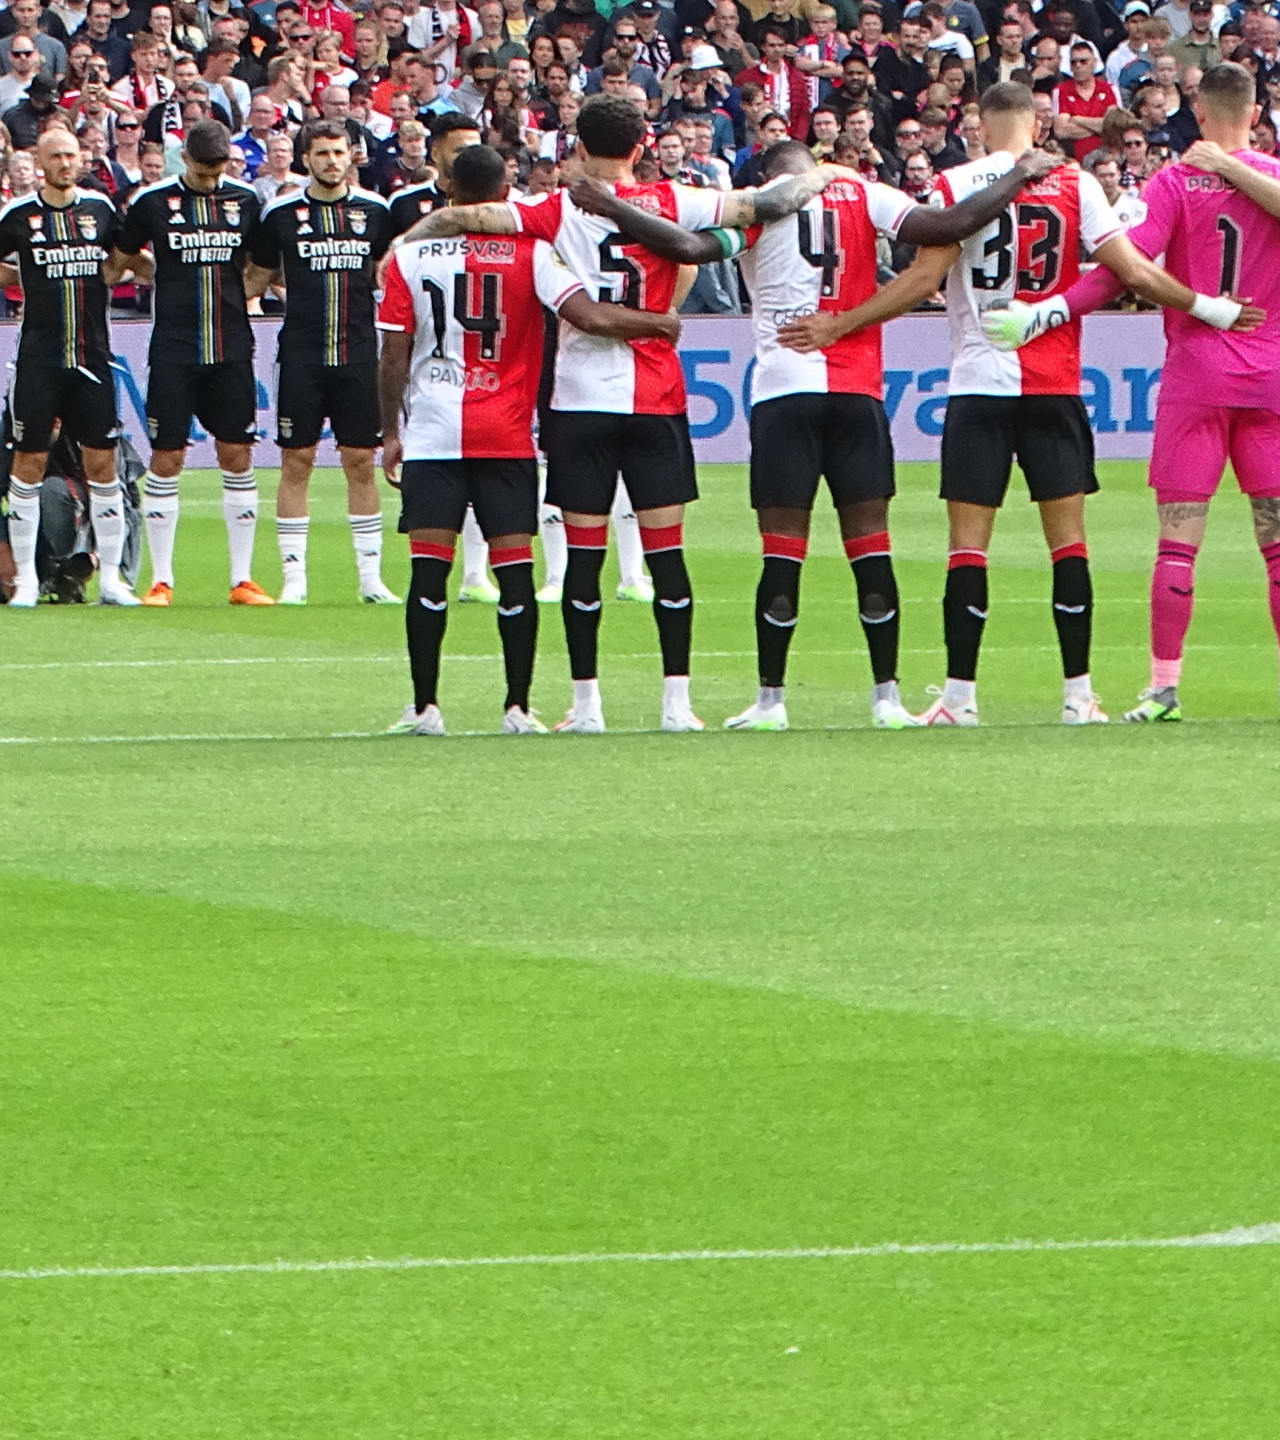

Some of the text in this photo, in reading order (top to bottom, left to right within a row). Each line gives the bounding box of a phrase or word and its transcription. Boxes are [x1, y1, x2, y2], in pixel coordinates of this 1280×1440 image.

[167, 229, 243, 250] Emirates
[296, 237, 372, 259] Emirates
[971, 202, 1067, 294] 33
[181, 248, 233, 263] FLY BETTER
[310, 254, 363, 271] FLY BETTER
[797, 209, 845, 300] 4
[1216, 213, 1243, 298] 1
[46, 261, 98, 279] FLY BETTER
[598, 228, 647, 311] 5
[422, 271, 507, 361] 14
[430, 365, 500, 391] PAIXÃO
